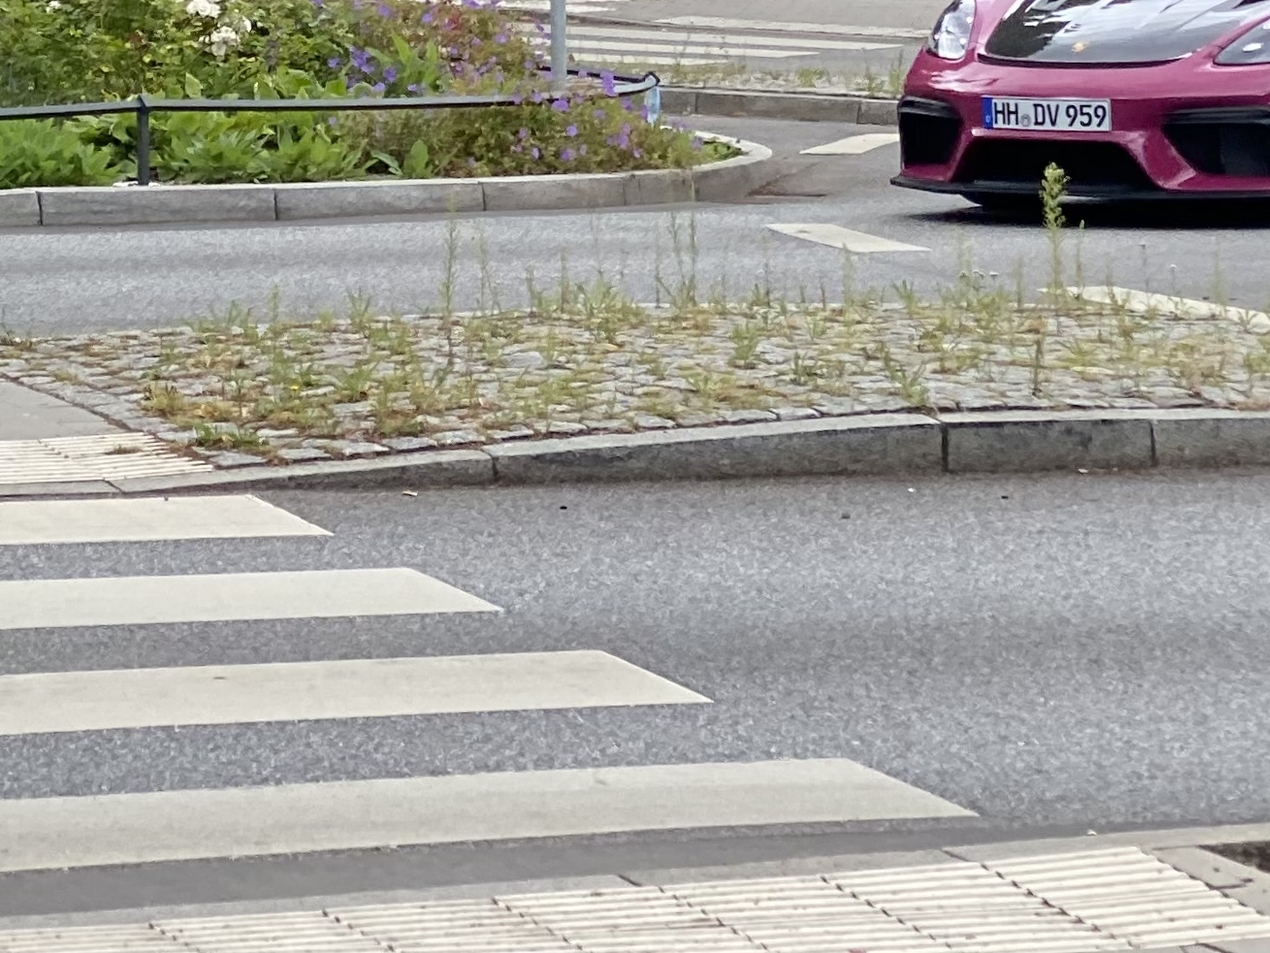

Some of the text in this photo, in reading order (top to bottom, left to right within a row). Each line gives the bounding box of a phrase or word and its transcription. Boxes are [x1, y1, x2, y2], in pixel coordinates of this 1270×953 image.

[994, 102, 1107, 128] HH DV 959
